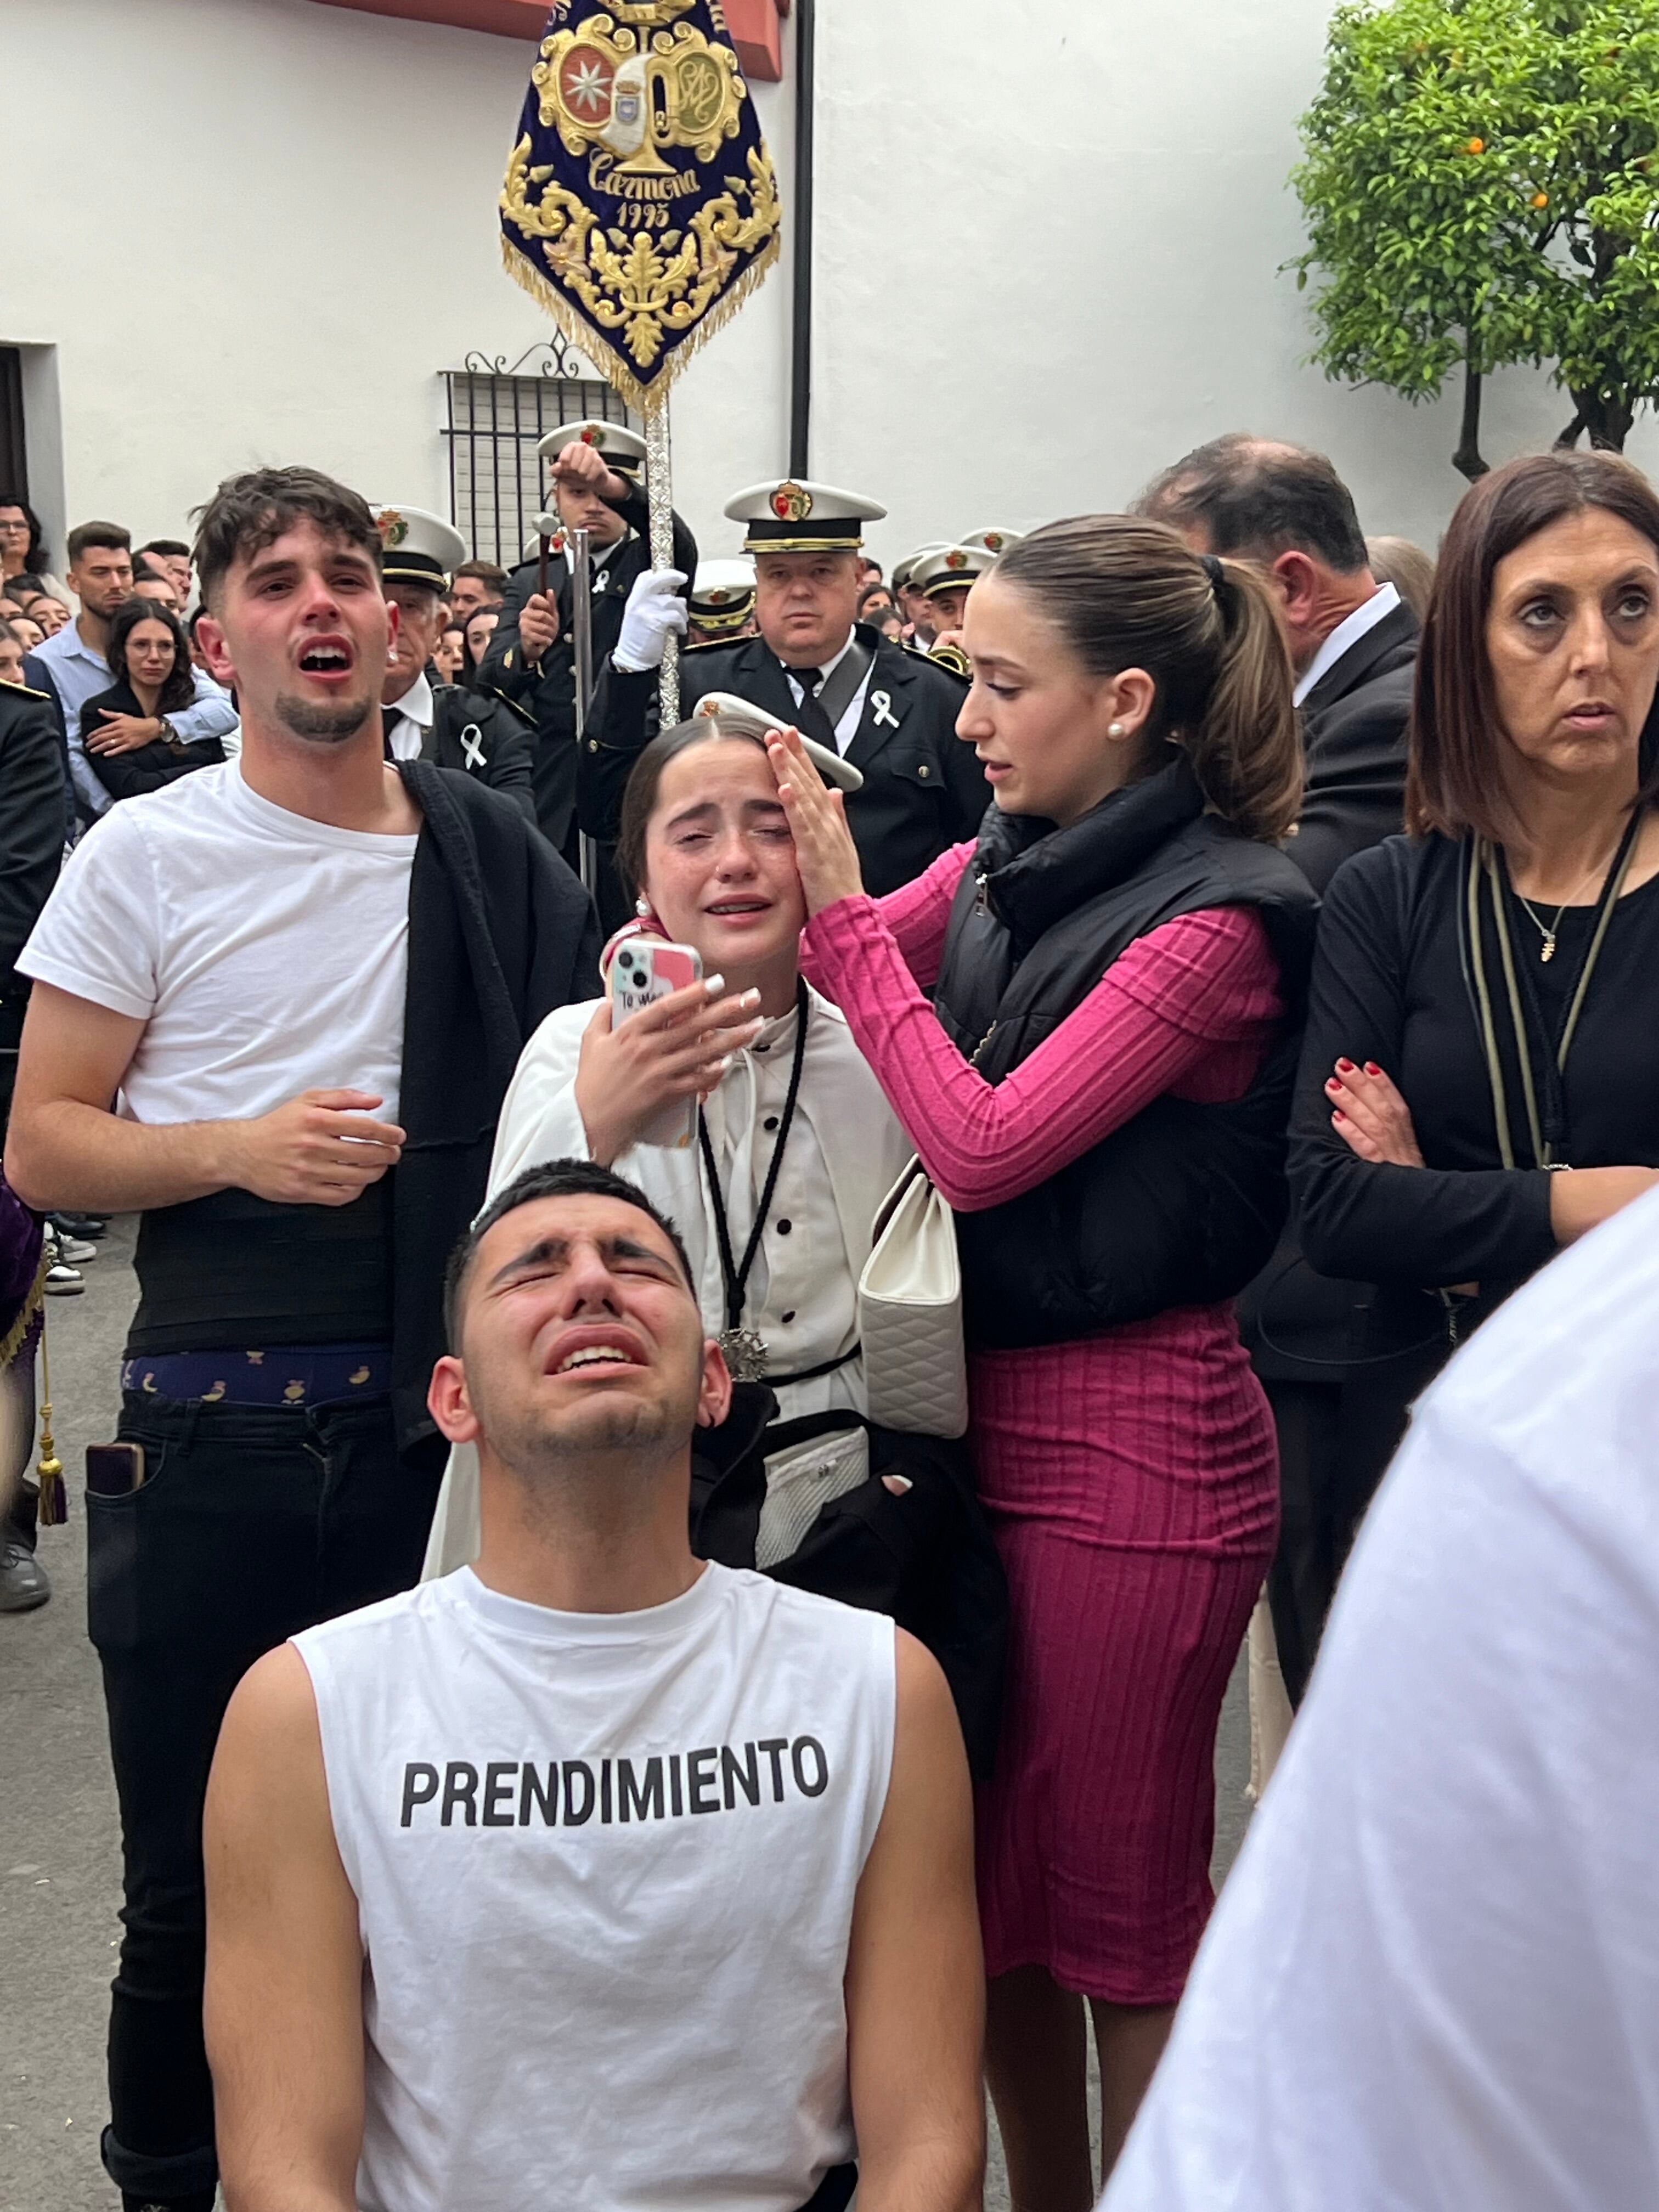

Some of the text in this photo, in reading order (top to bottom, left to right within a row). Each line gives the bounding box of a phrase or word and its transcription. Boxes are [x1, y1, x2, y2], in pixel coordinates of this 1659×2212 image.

[589, 147, 701, 200] Carmona
[617, 202, 669, 229] 1995
[400, 1735, 829, 1828] PRENDIMIENTO
